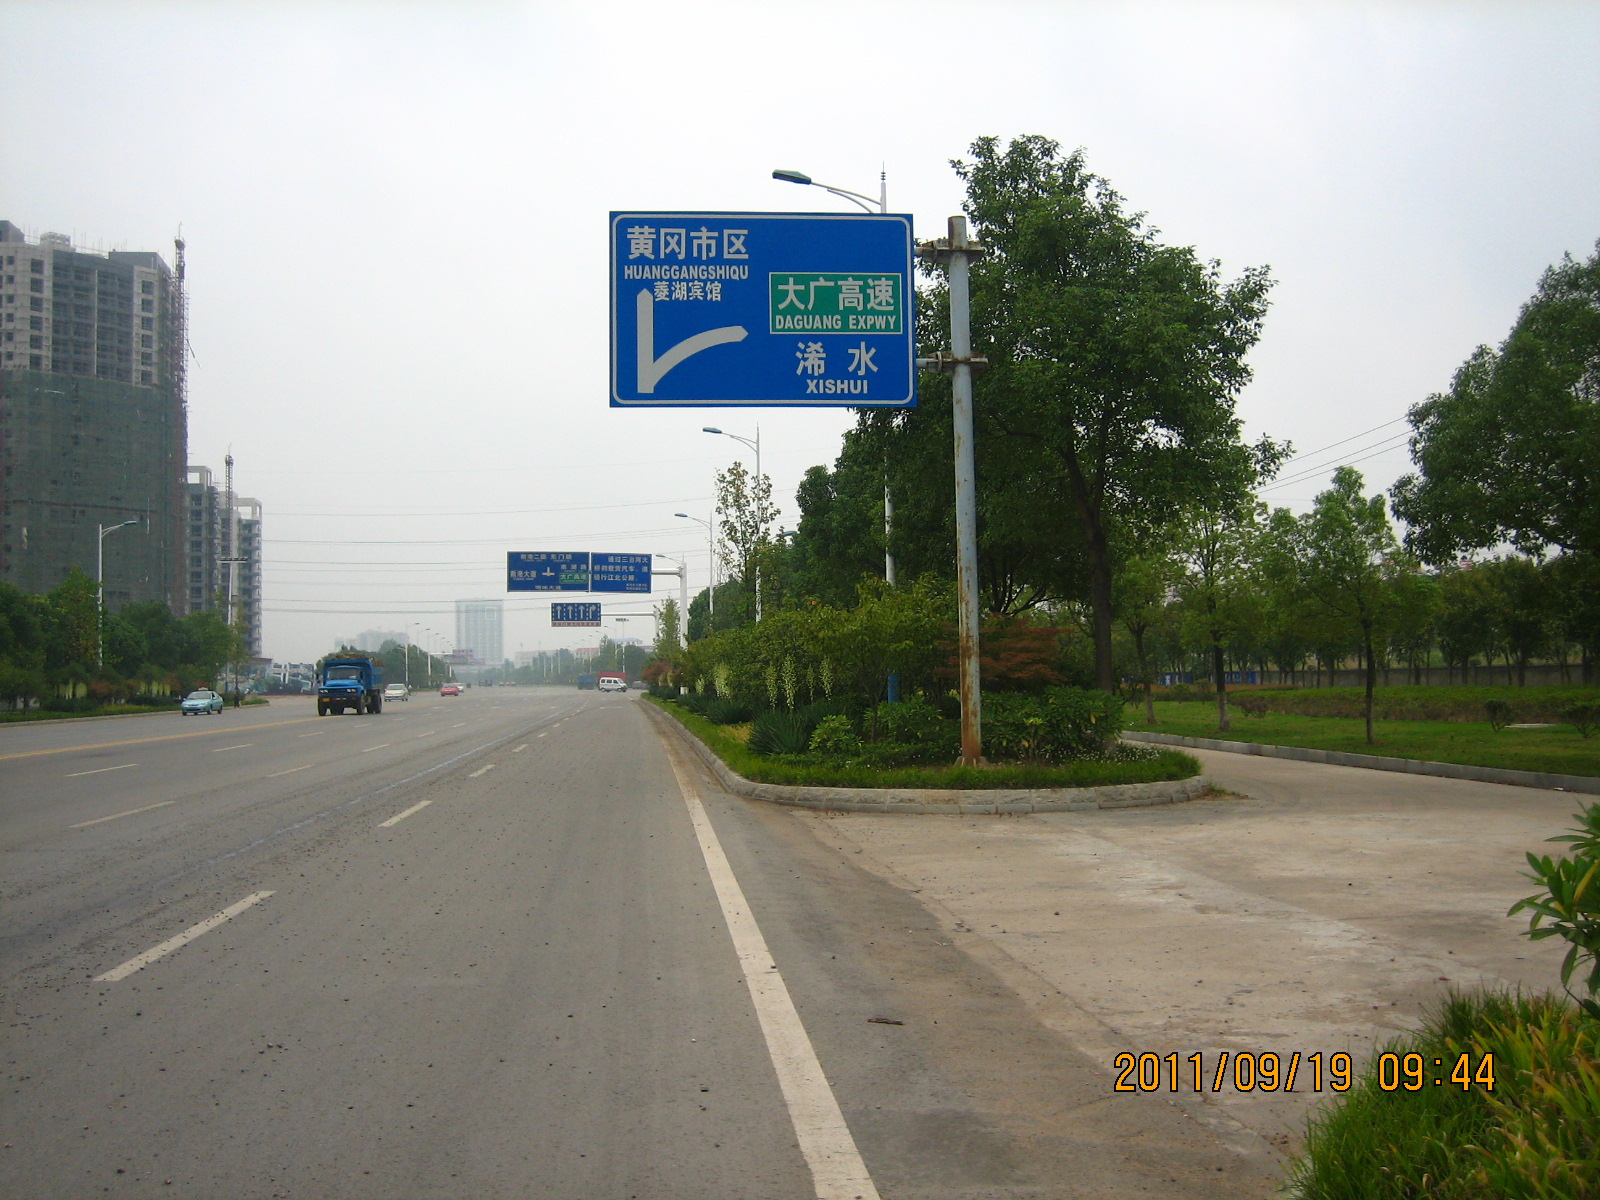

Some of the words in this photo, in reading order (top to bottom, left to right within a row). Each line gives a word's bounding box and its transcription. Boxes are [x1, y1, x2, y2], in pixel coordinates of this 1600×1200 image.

[626, 225, 749, 261] 黄冈市区
[624, 265, 749, 281] HUANGGANGSHIQU
[653, 281, 723, 302] 菱湖宾馆
[777, 276, 895, 312] 大广高速
[775, 314, 842, 330] DAGUANG
[848, 315, 897, 330] EXPWY
[795, 341, 879, 377] 浠水
[806, 379, 868, 394] XISHUI
